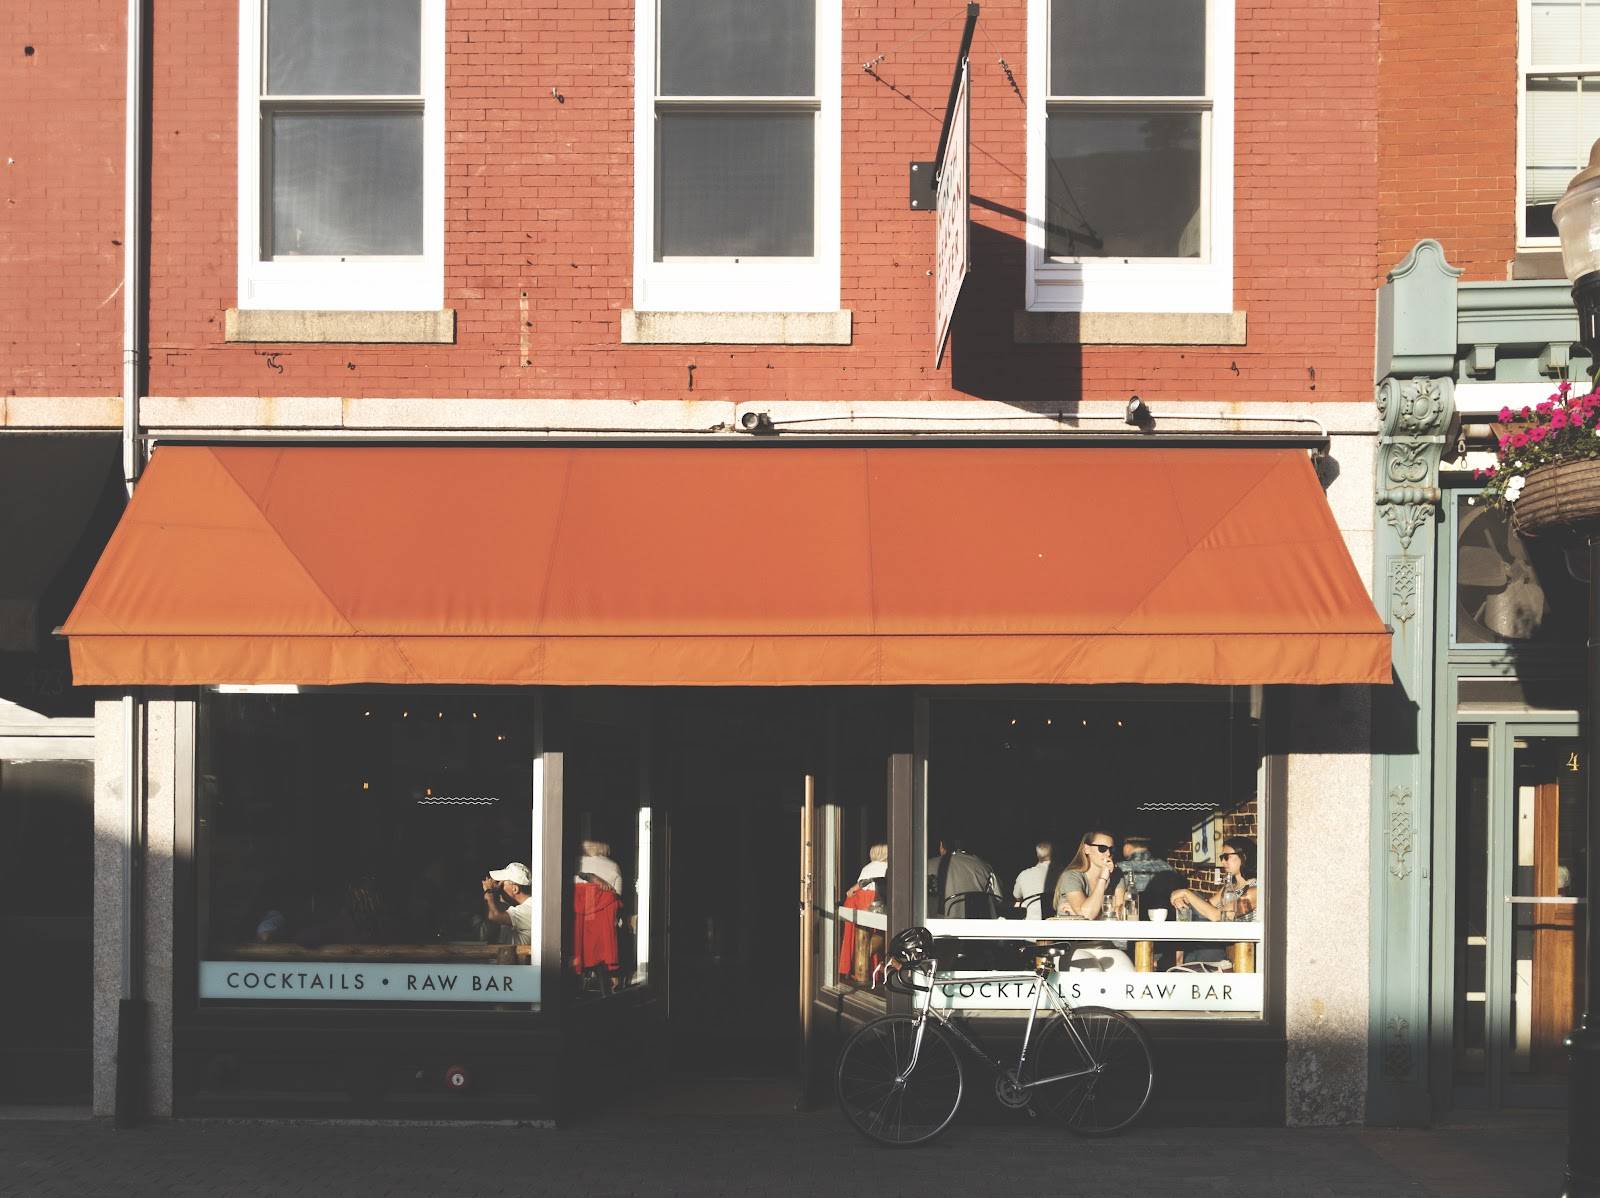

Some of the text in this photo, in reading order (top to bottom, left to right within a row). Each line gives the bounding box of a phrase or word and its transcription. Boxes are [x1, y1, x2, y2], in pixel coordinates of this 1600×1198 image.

[226, 972, 513, 992] COCKTAILS RAW BAR
[942, 982, 1233, 1000] COCKTALS RAW BAR
